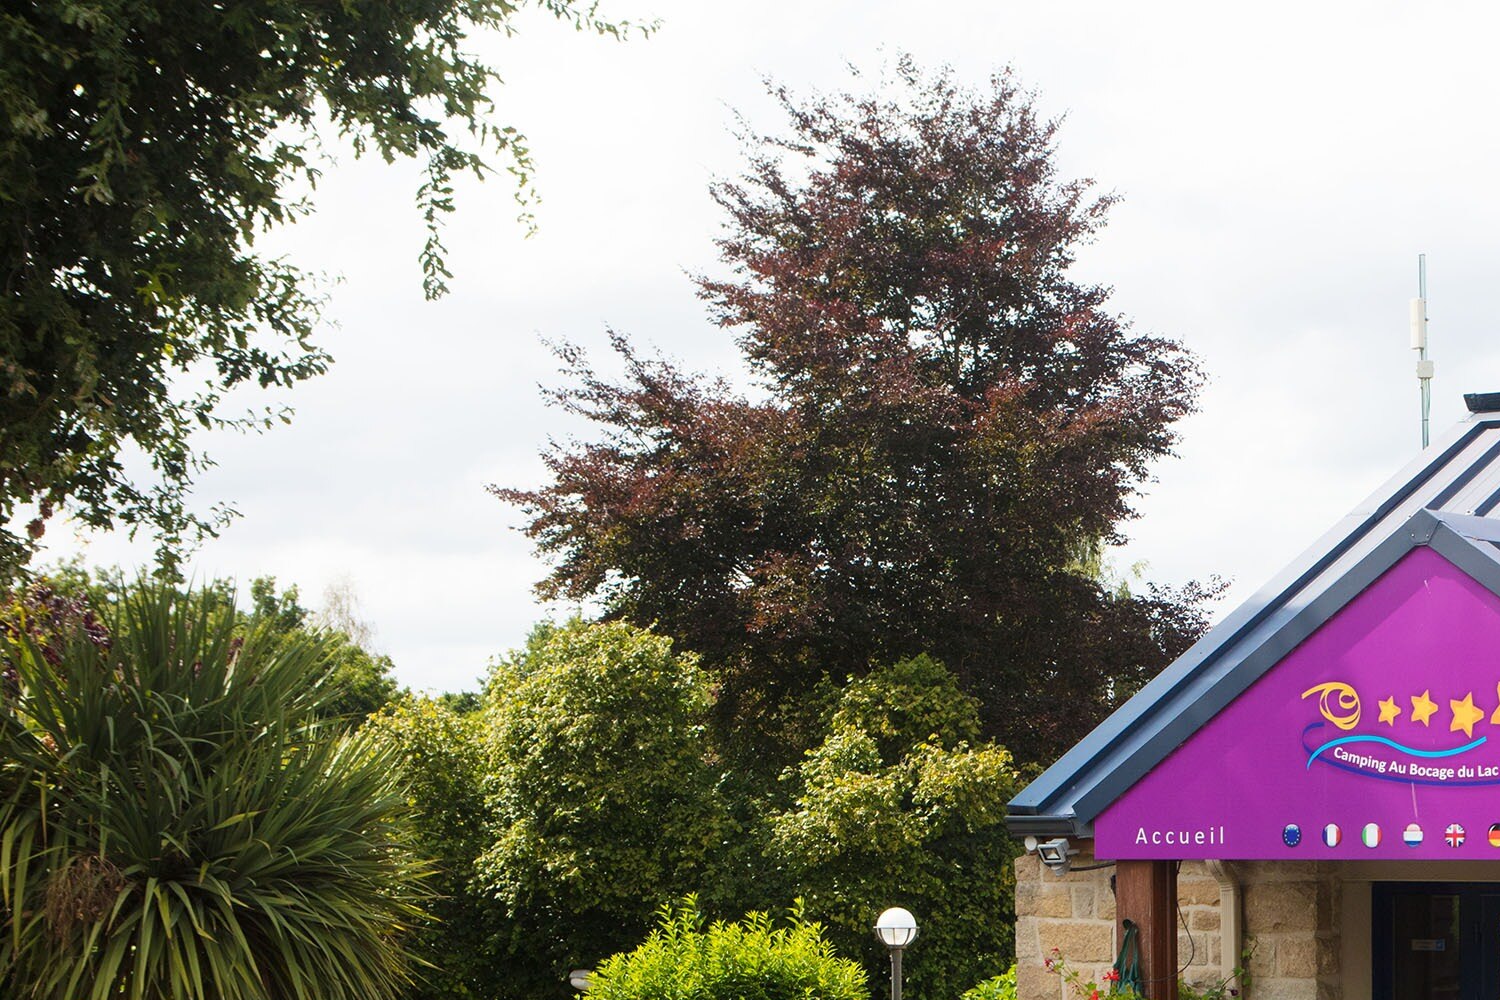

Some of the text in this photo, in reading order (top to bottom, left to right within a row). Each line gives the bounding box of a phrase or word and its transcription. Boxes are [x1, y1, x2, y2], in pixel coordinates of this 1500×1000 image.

[1334, 747, 1499, 780] Camping Au Bocage du Lac
[1135, 826, 1224, 844] Accueil
